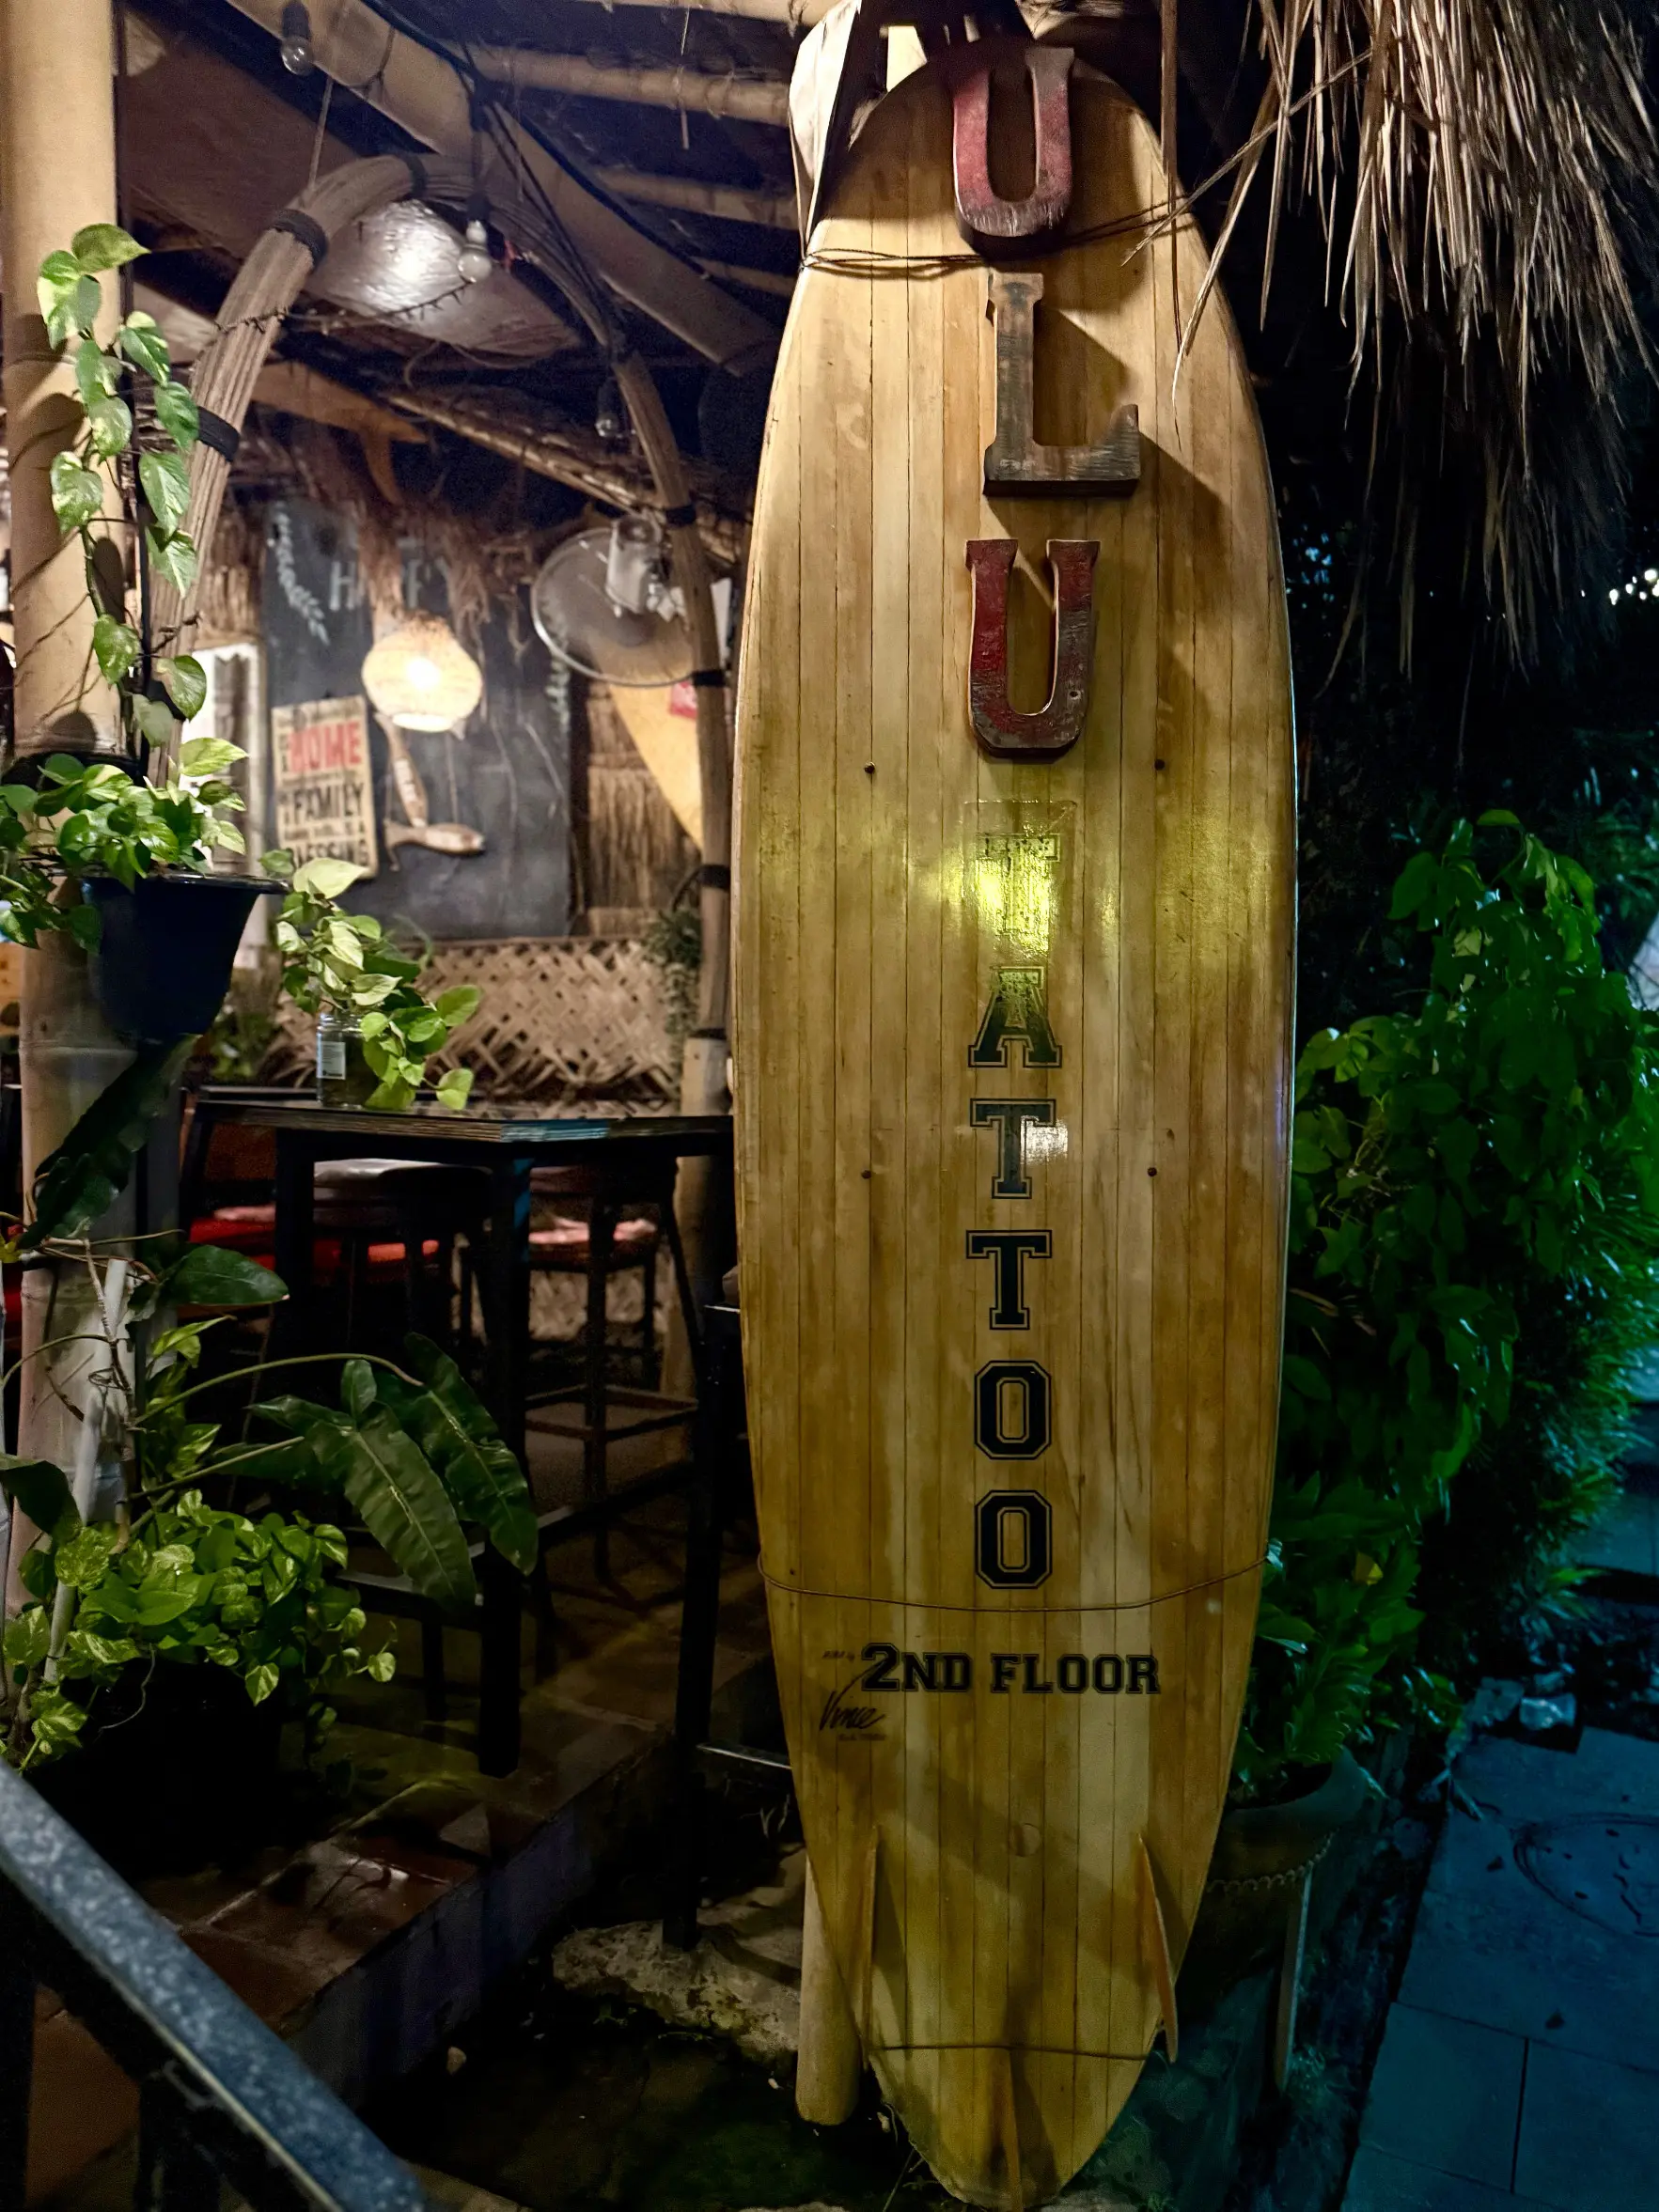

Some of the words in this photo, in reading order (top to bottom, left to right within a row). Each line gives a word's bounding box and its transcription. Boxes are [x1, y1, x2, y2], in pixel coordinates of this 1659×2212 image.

[949, 47, 1141, 759] ULU
[289, 722, 361, 772] HOME
[293, 782, 365, 826] FAMILY
[966, 833, 1063, 1590] TATTOO
[860, 1643, 973, 1692] 2ND
[990, 1653, 1161, 1694] FLOOR
